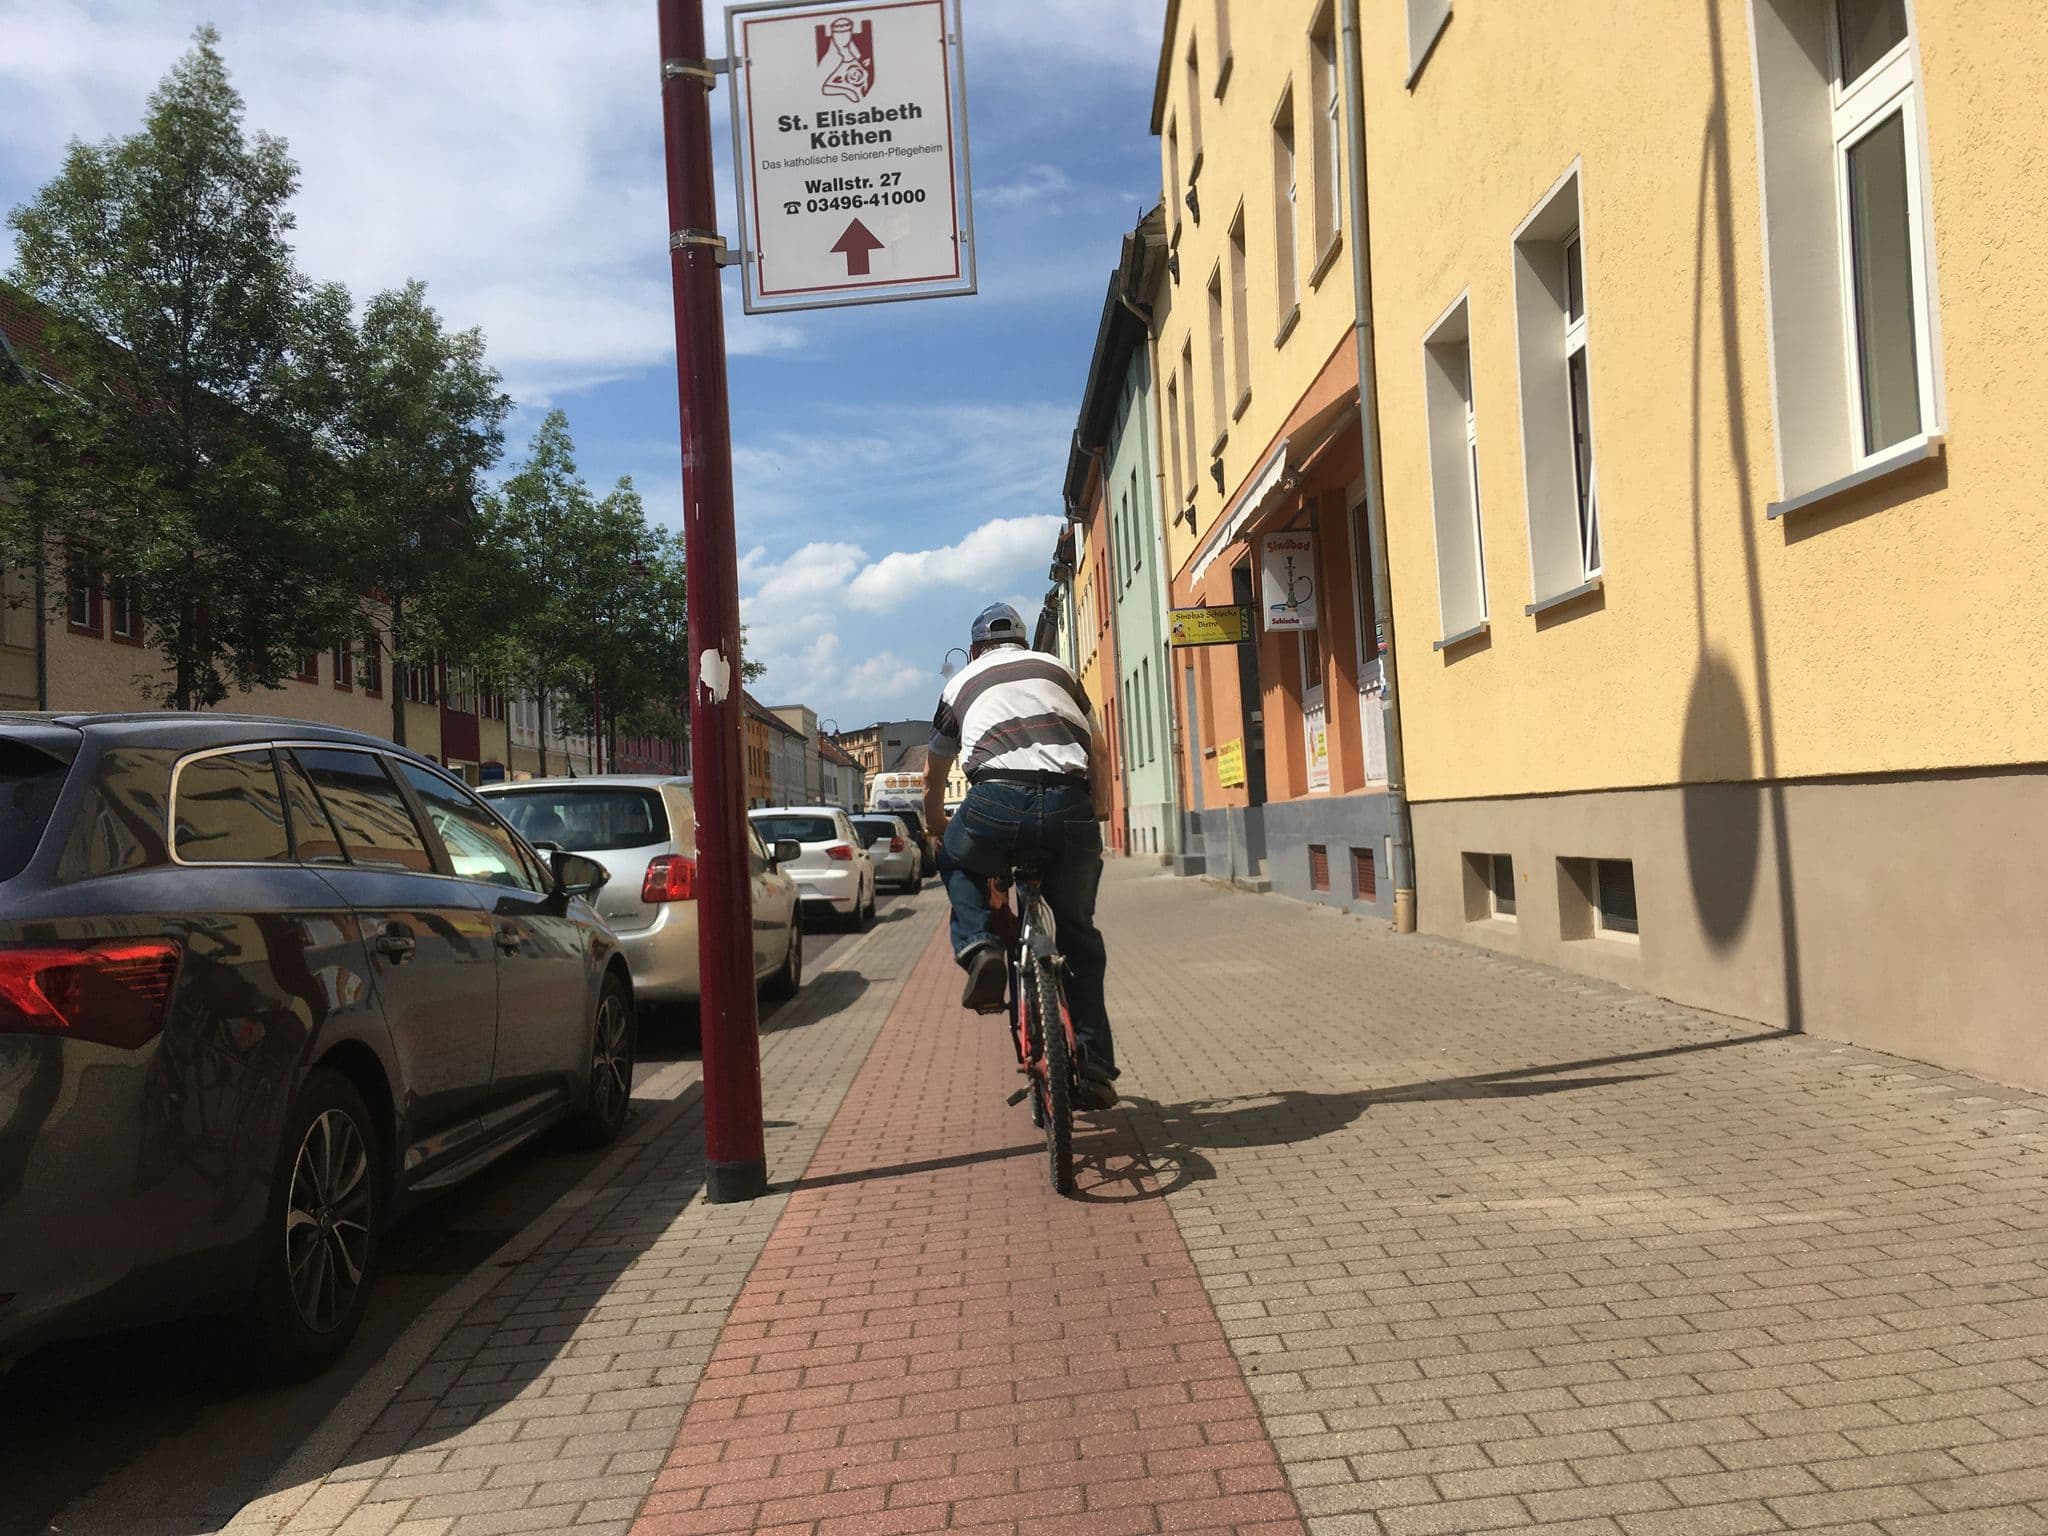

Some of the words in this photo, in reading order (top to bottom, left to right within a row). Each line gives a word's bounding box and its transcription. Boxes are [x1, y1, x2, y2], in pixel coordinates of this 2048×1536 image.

[778, 114, 808, 132] St.
[816, 103, 922, 129] Elisabeth
[810, 129, 892, 149] Köthen
[762, 159, 781, 170] Das
[784, 153, 838, 168] katholische
[841, 144, 943, 162] Senioren-Pflegeheim
[805, 176, 873, 194] Wallstr.
[880, 172, 902, 187] 27
[807, 189, 926, 213] 03496-41000
[1267, 539, 1310, 552] Sindbad
